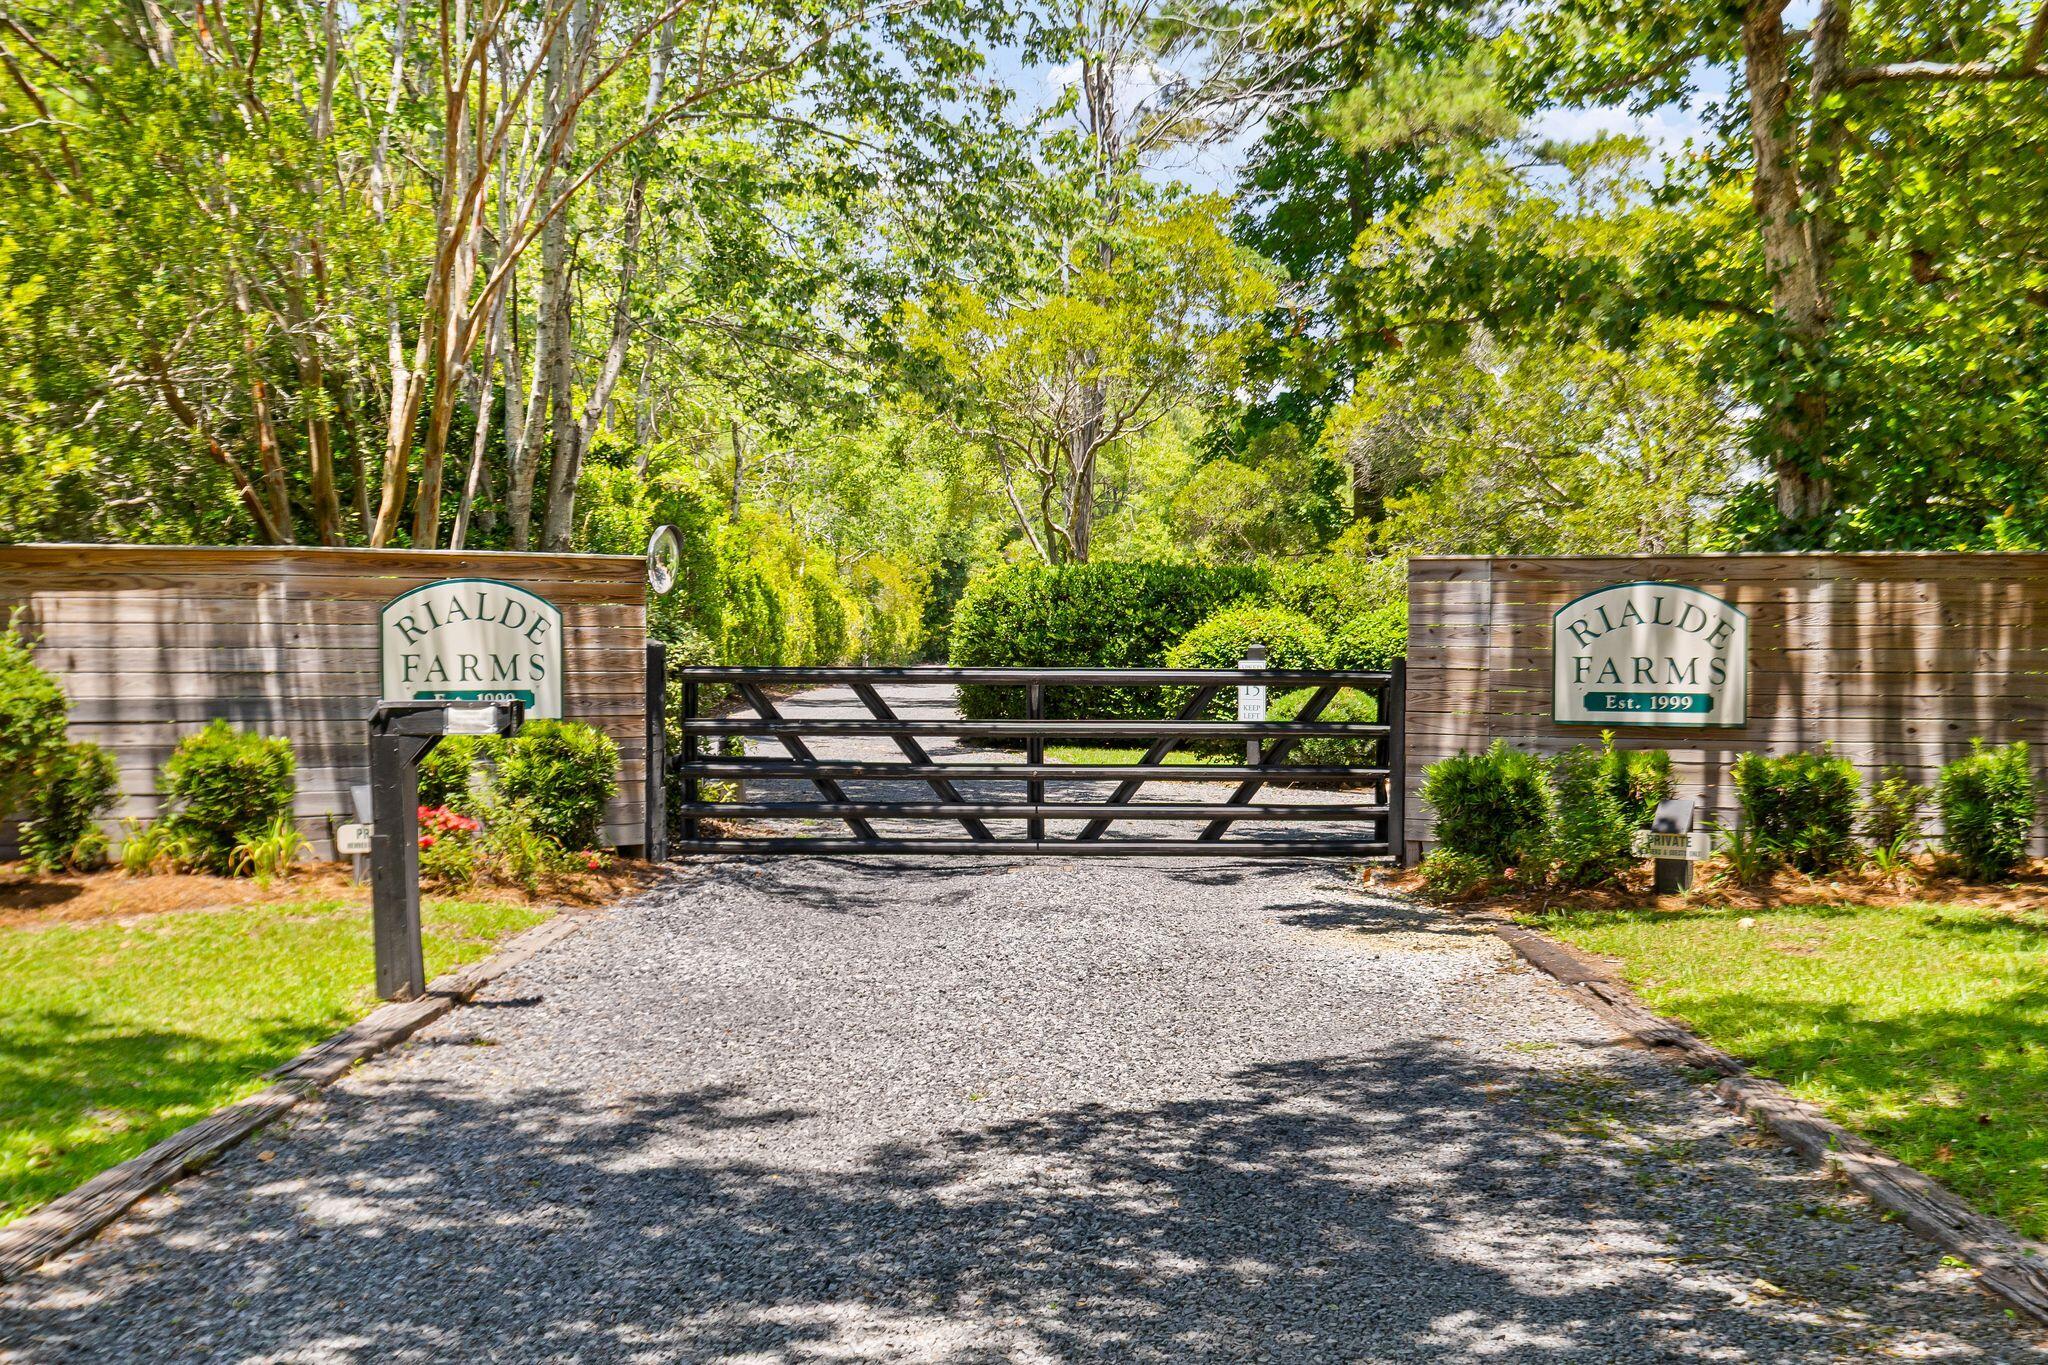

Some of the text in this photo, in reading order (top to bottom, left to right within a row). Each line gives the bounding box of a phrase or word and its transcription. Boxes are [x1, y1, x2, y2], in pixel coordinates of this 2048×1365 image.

[393, 591, 552, 647] RIALDE
[1564, 596, 1736, 651] RIALDE
[400, 653, 546, 682] FARMS
[1572, 656, 1727, 685] FARMS
[1605, 695, 1693, 711] Est. 1999
[1647, 834, 1692, 847] PRIVATE
